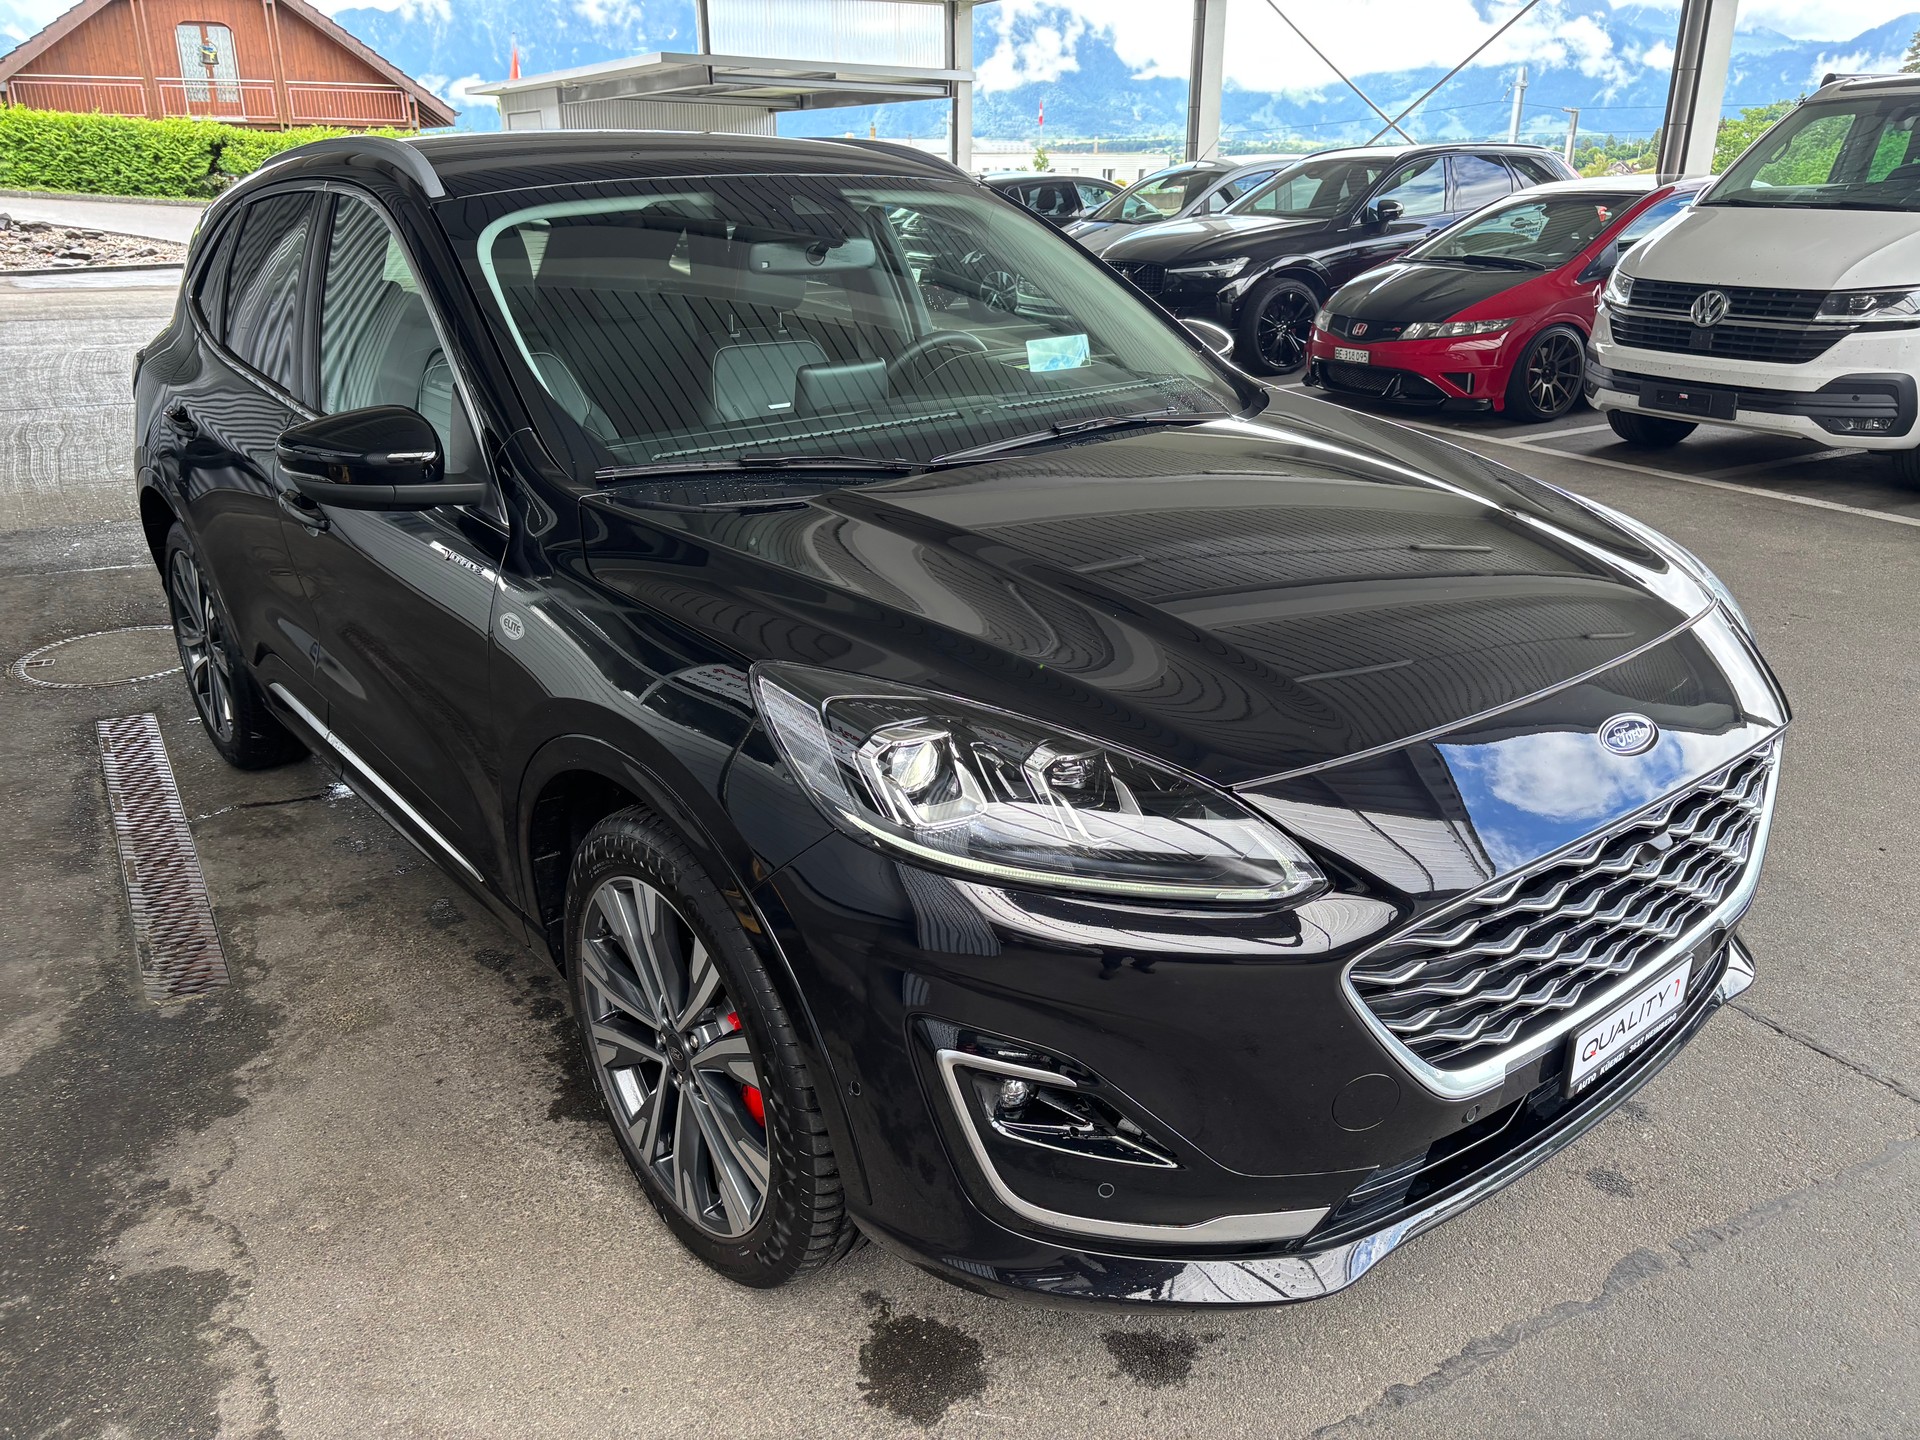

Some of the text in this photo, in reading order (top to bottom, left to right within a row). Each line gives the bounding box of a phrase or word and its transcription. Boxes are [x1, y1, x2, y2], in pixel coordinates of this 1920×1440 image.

[503, 617, 522, 635] ELITE
[1613, 722, 1645, 747] Ford
[1582, 984, 1671, 1062] QUALITY
[1577, 1072, 1597, 1092] AUTO
